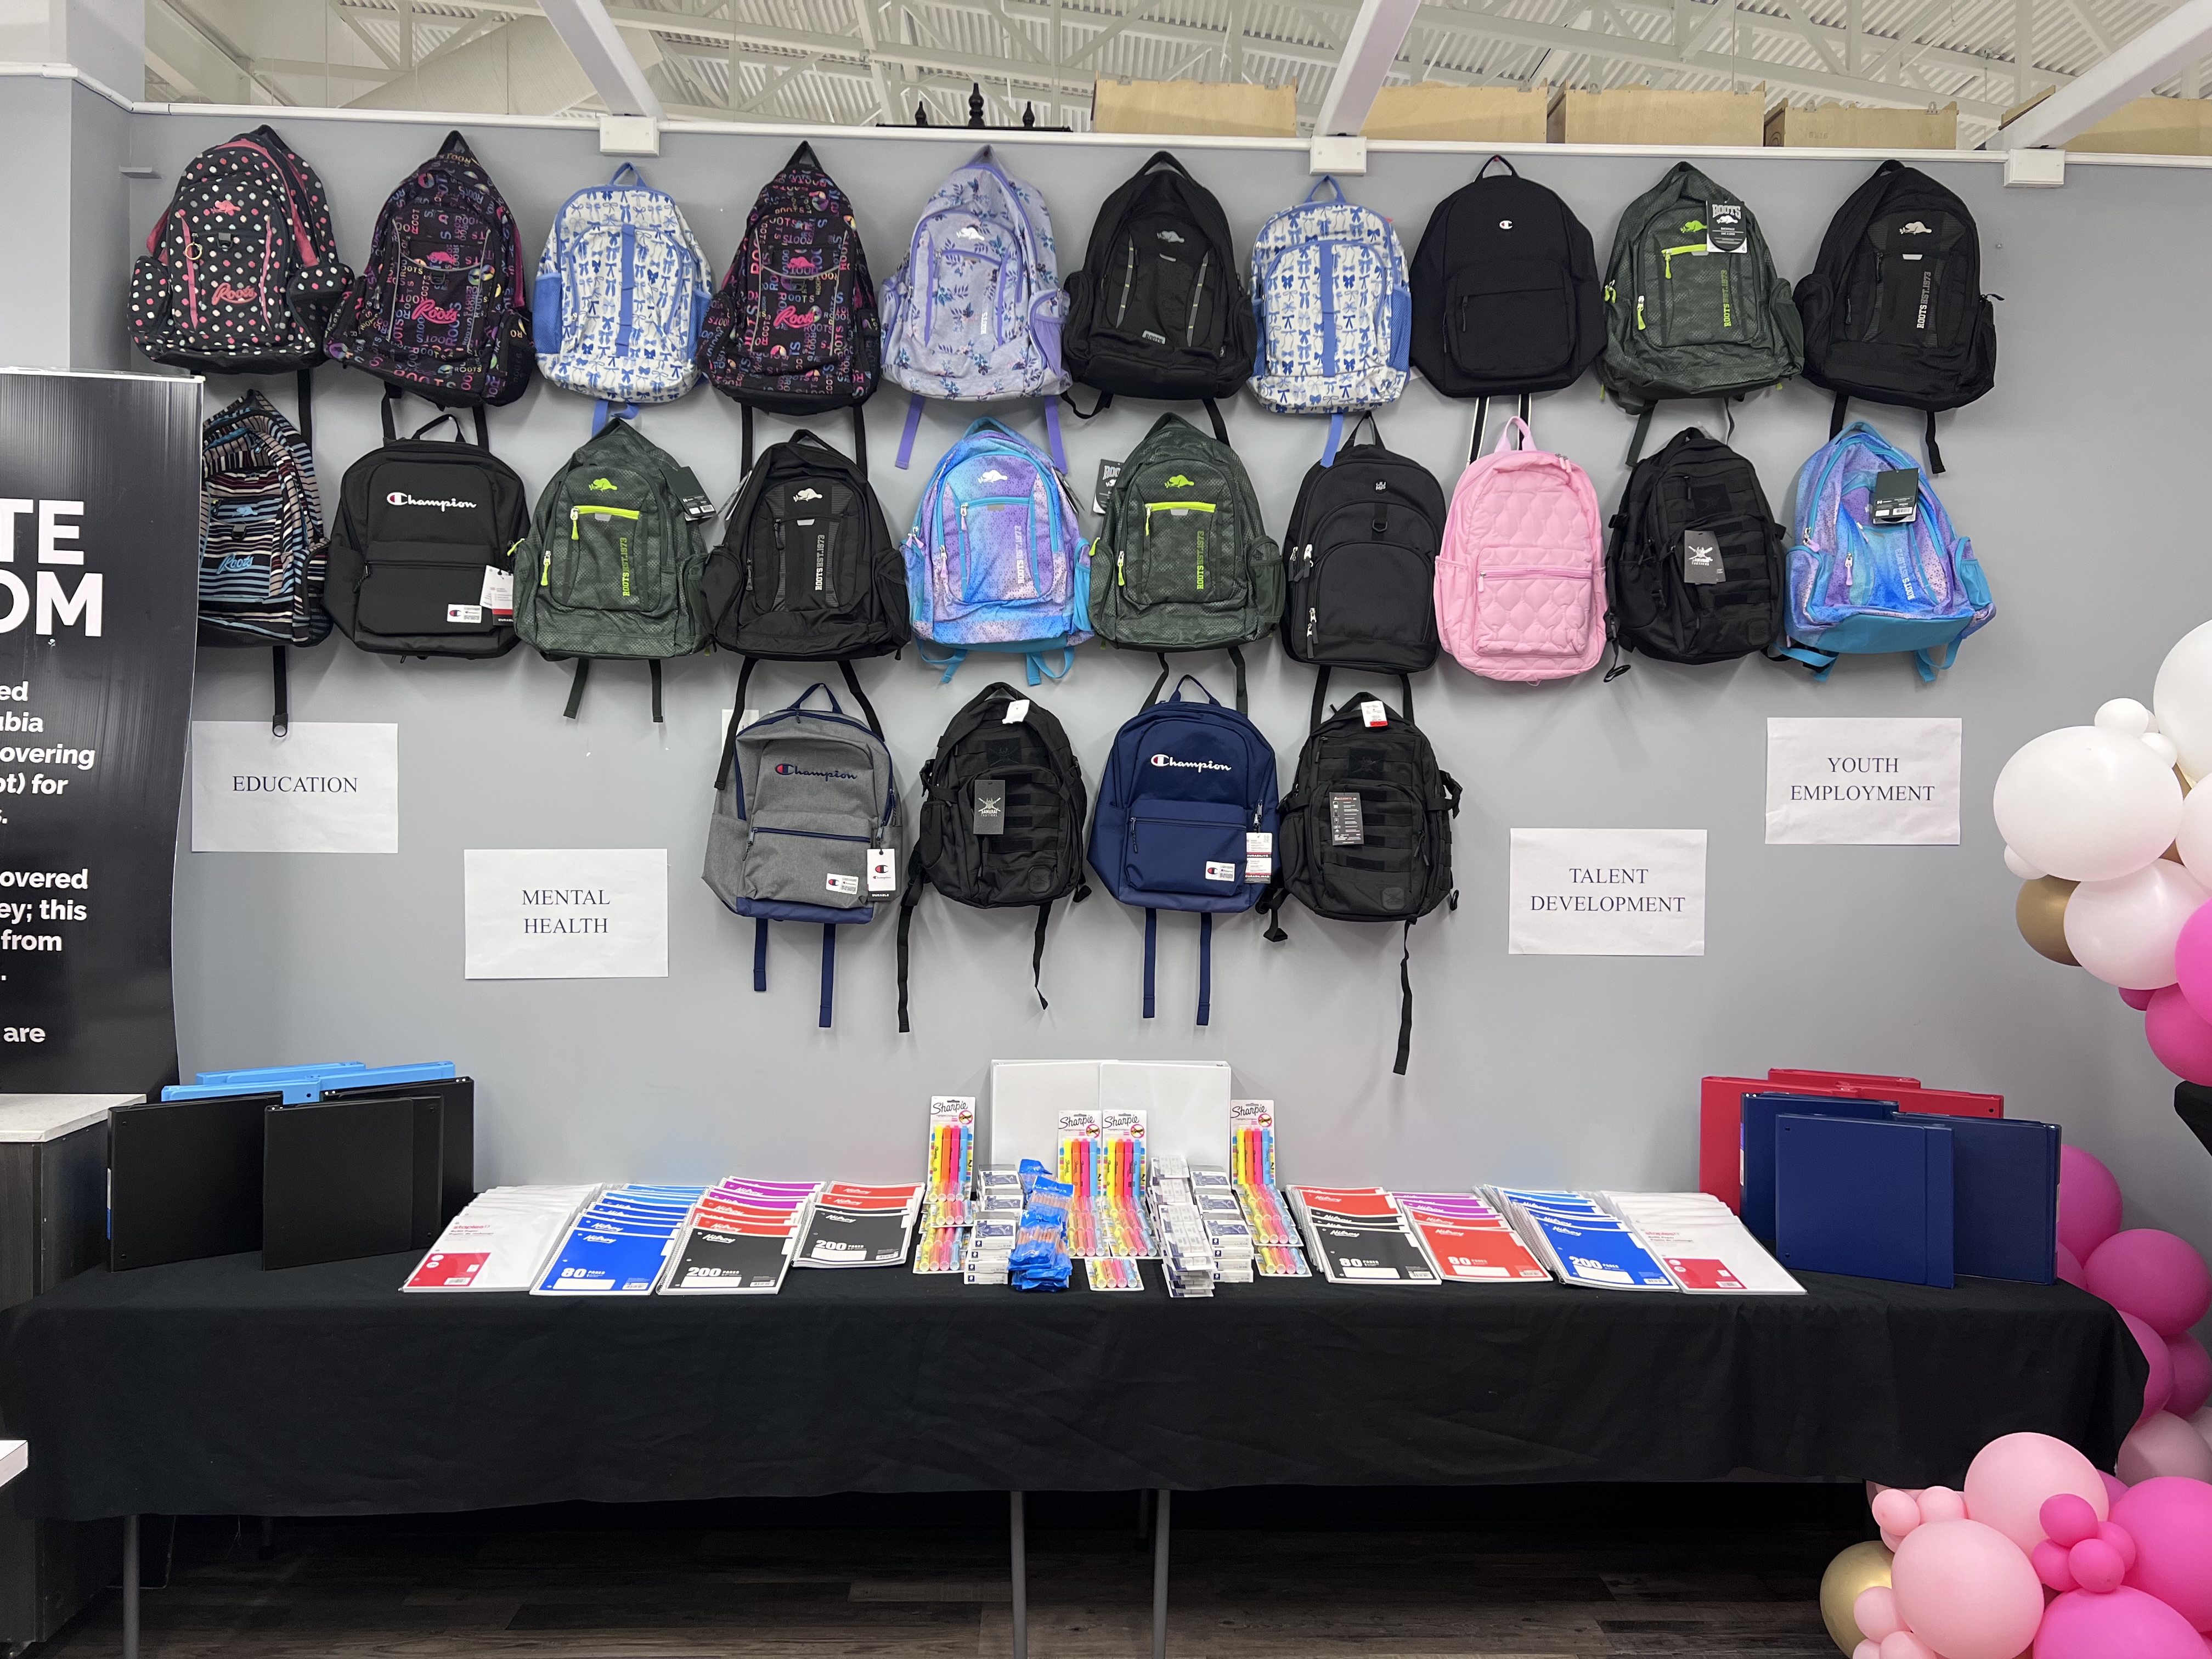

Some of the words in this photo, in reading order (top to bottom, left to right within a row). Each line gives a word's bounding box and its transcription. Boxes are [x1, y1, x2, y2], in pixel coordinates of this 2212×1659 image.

[1712, 204, 1741, 219] ROOTS
[211, 281, 258, 306] Roots
[411, 299, 458, 324] Roots
[773, 305, 815, 329] Roots
[1916, 304, 1927, 329] ROOTS
[387, 492, 477, 512] Champion
[0, 498, 84, 565] TE
[216, 553, 254, 574] Roots
[622, 572, 630, 596] ROOTS
[815, 568, 823, 590] ROOTS
[1902, 578, 1915, 600] ROOTS
[0, 712, 44, 732] bia
[0, 743, 95, 770] overing
[1150, 754, 1232, 772] Champion
[1827, 757, 1899, 772] YOUTH
[775, 763, 858, 782] Champion
[31, 774, 69, 794] for
[232, 775, 358, 793] EDUCATION
[1790, 785, 1935, 801] EMPLOYMENT
[0, 868, 88, 890] overed
[1569, 868, 1649, 884] TALENT
[522, 889, 611, 905] MENTAL
[1531, 895, 1685, 912] DEVELOPMENT
[40, 900, 87, 921] this
[523, 918, 608, 933] HEALTH
[1, 930, 63, 951] from
[3, 1026, 46, 1043] are
[930, 1101, 968, 1114] Sharpie
[1231, 1104, 1267, 1118] Sharpie
[1058, 1114, 1095, 1129] Sharpie
[1103, 1114, 1139, 1128] Sharpie
[815, 1240, 847, 1250] 200
[1339, 1258, 1363, 1267] 80
[1448, 1256, 1471, 1265] 80
[1569, 1256, 1602, 1269] 200
[561, 1268, 587, 1278] 80
[686, 1267, 722, 1277] 200
